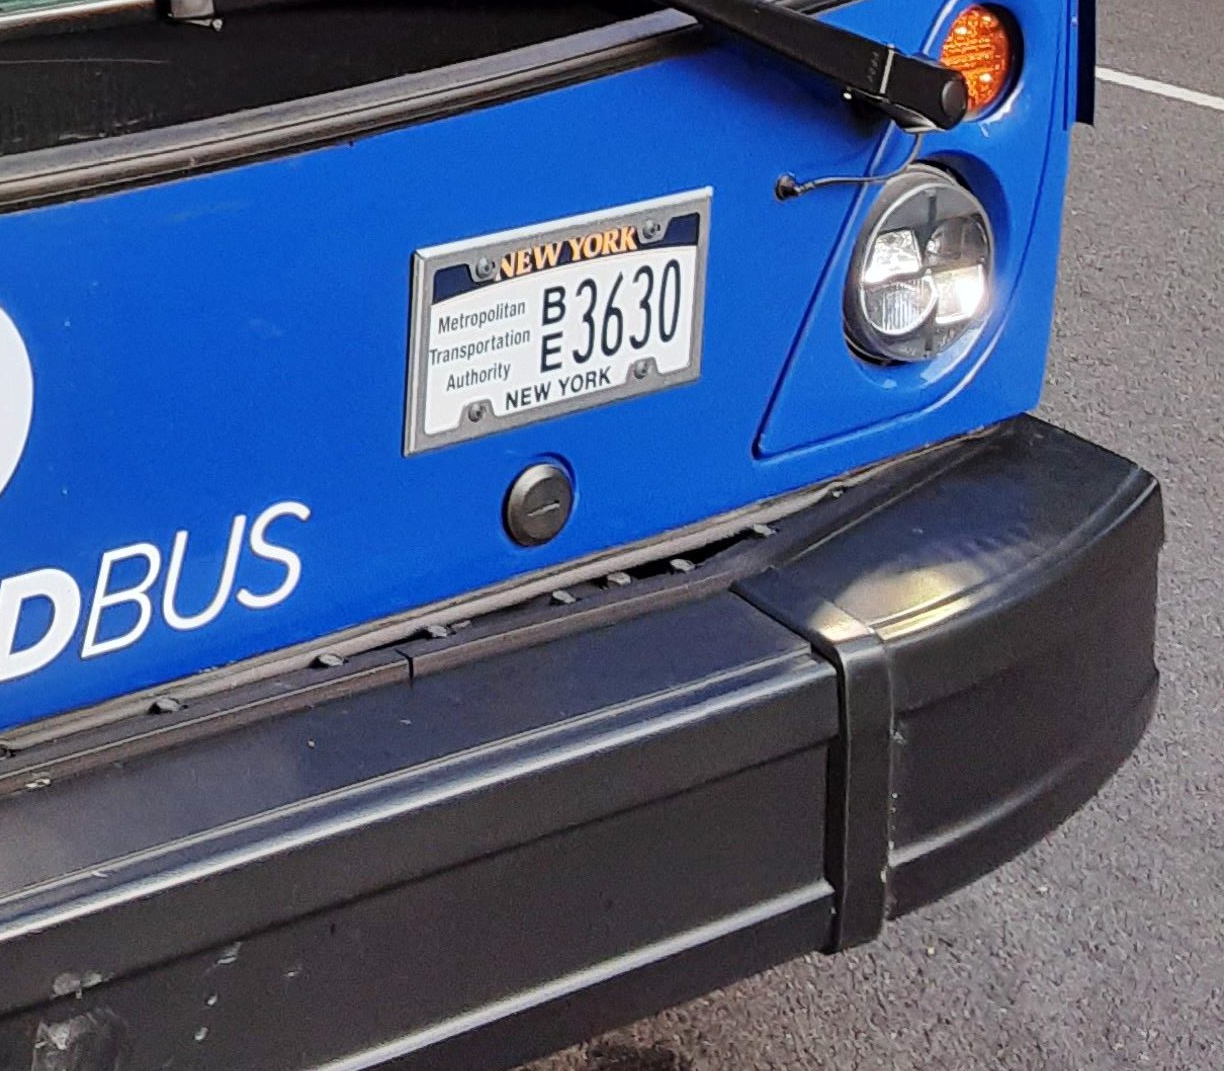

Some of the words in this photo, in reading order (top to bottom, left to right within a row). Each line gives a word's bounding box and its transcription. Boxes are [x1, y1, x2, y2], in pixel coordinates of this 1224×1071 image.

[495, 242, 562, 281] NEW
[570, 225, 638, 262] YORK
[437, 301, 526, 333] Metropolitan
[572, 259, 681, 363] 3630
[429, 329, 531, 366] Transportation
[446, 363, 511, 392] Authority
[505, 381, 551, 411] NEW
[558, 366, 612, 397] YORK
